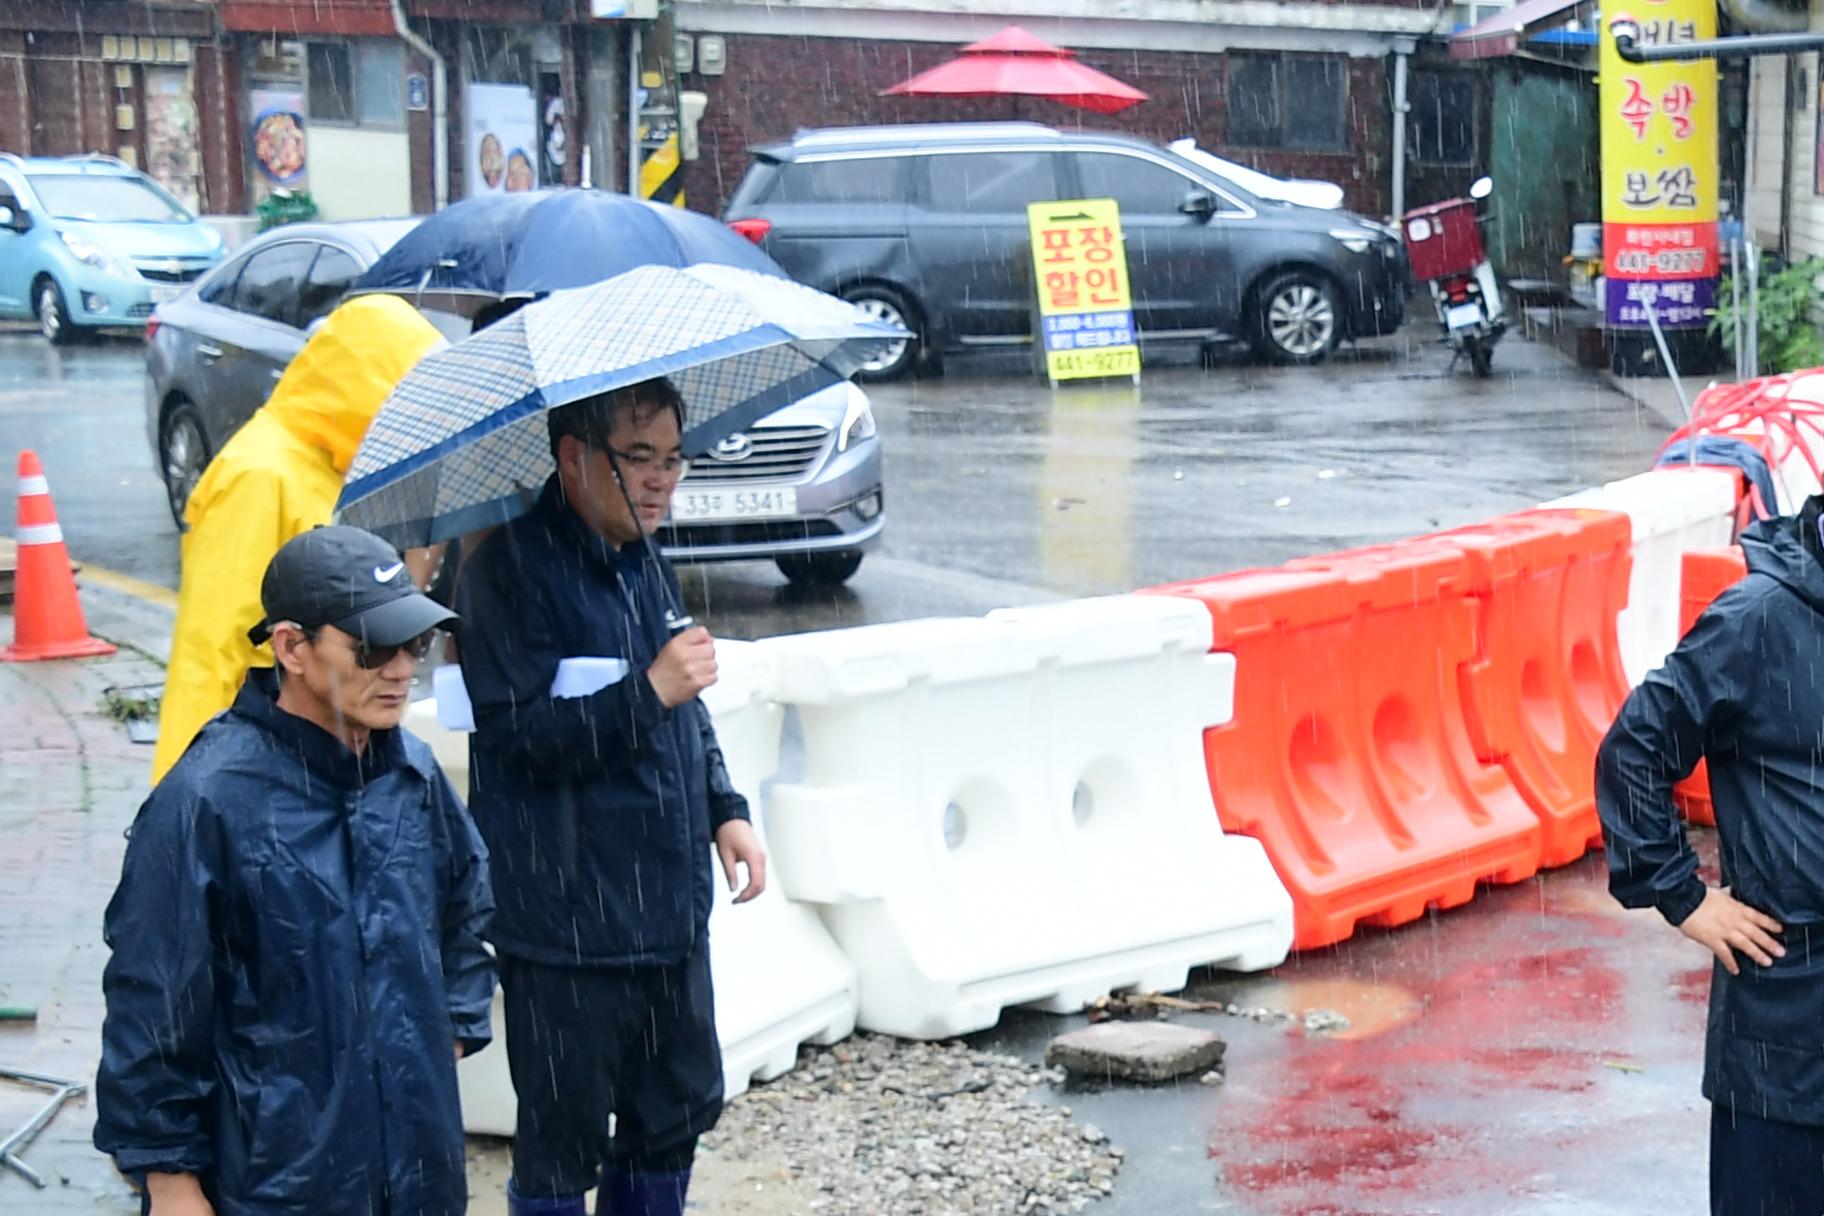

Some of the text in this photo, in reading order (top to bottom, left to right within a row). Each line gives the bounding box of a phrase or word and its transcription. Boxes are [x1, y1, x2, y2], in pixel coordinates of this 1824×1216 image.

[1620, 78, 1695, 140] 족발
[1621, 167, 1696, 207] 보쌈
[1041, 226, 1114, 263] 포장
[1615, 249, 1705, 273] 441-9277
[1045, 268, 1120, 307] 할인
[1056, 351, 1133, 371] 441-9277
[735, 491, 783, 514] 5341
